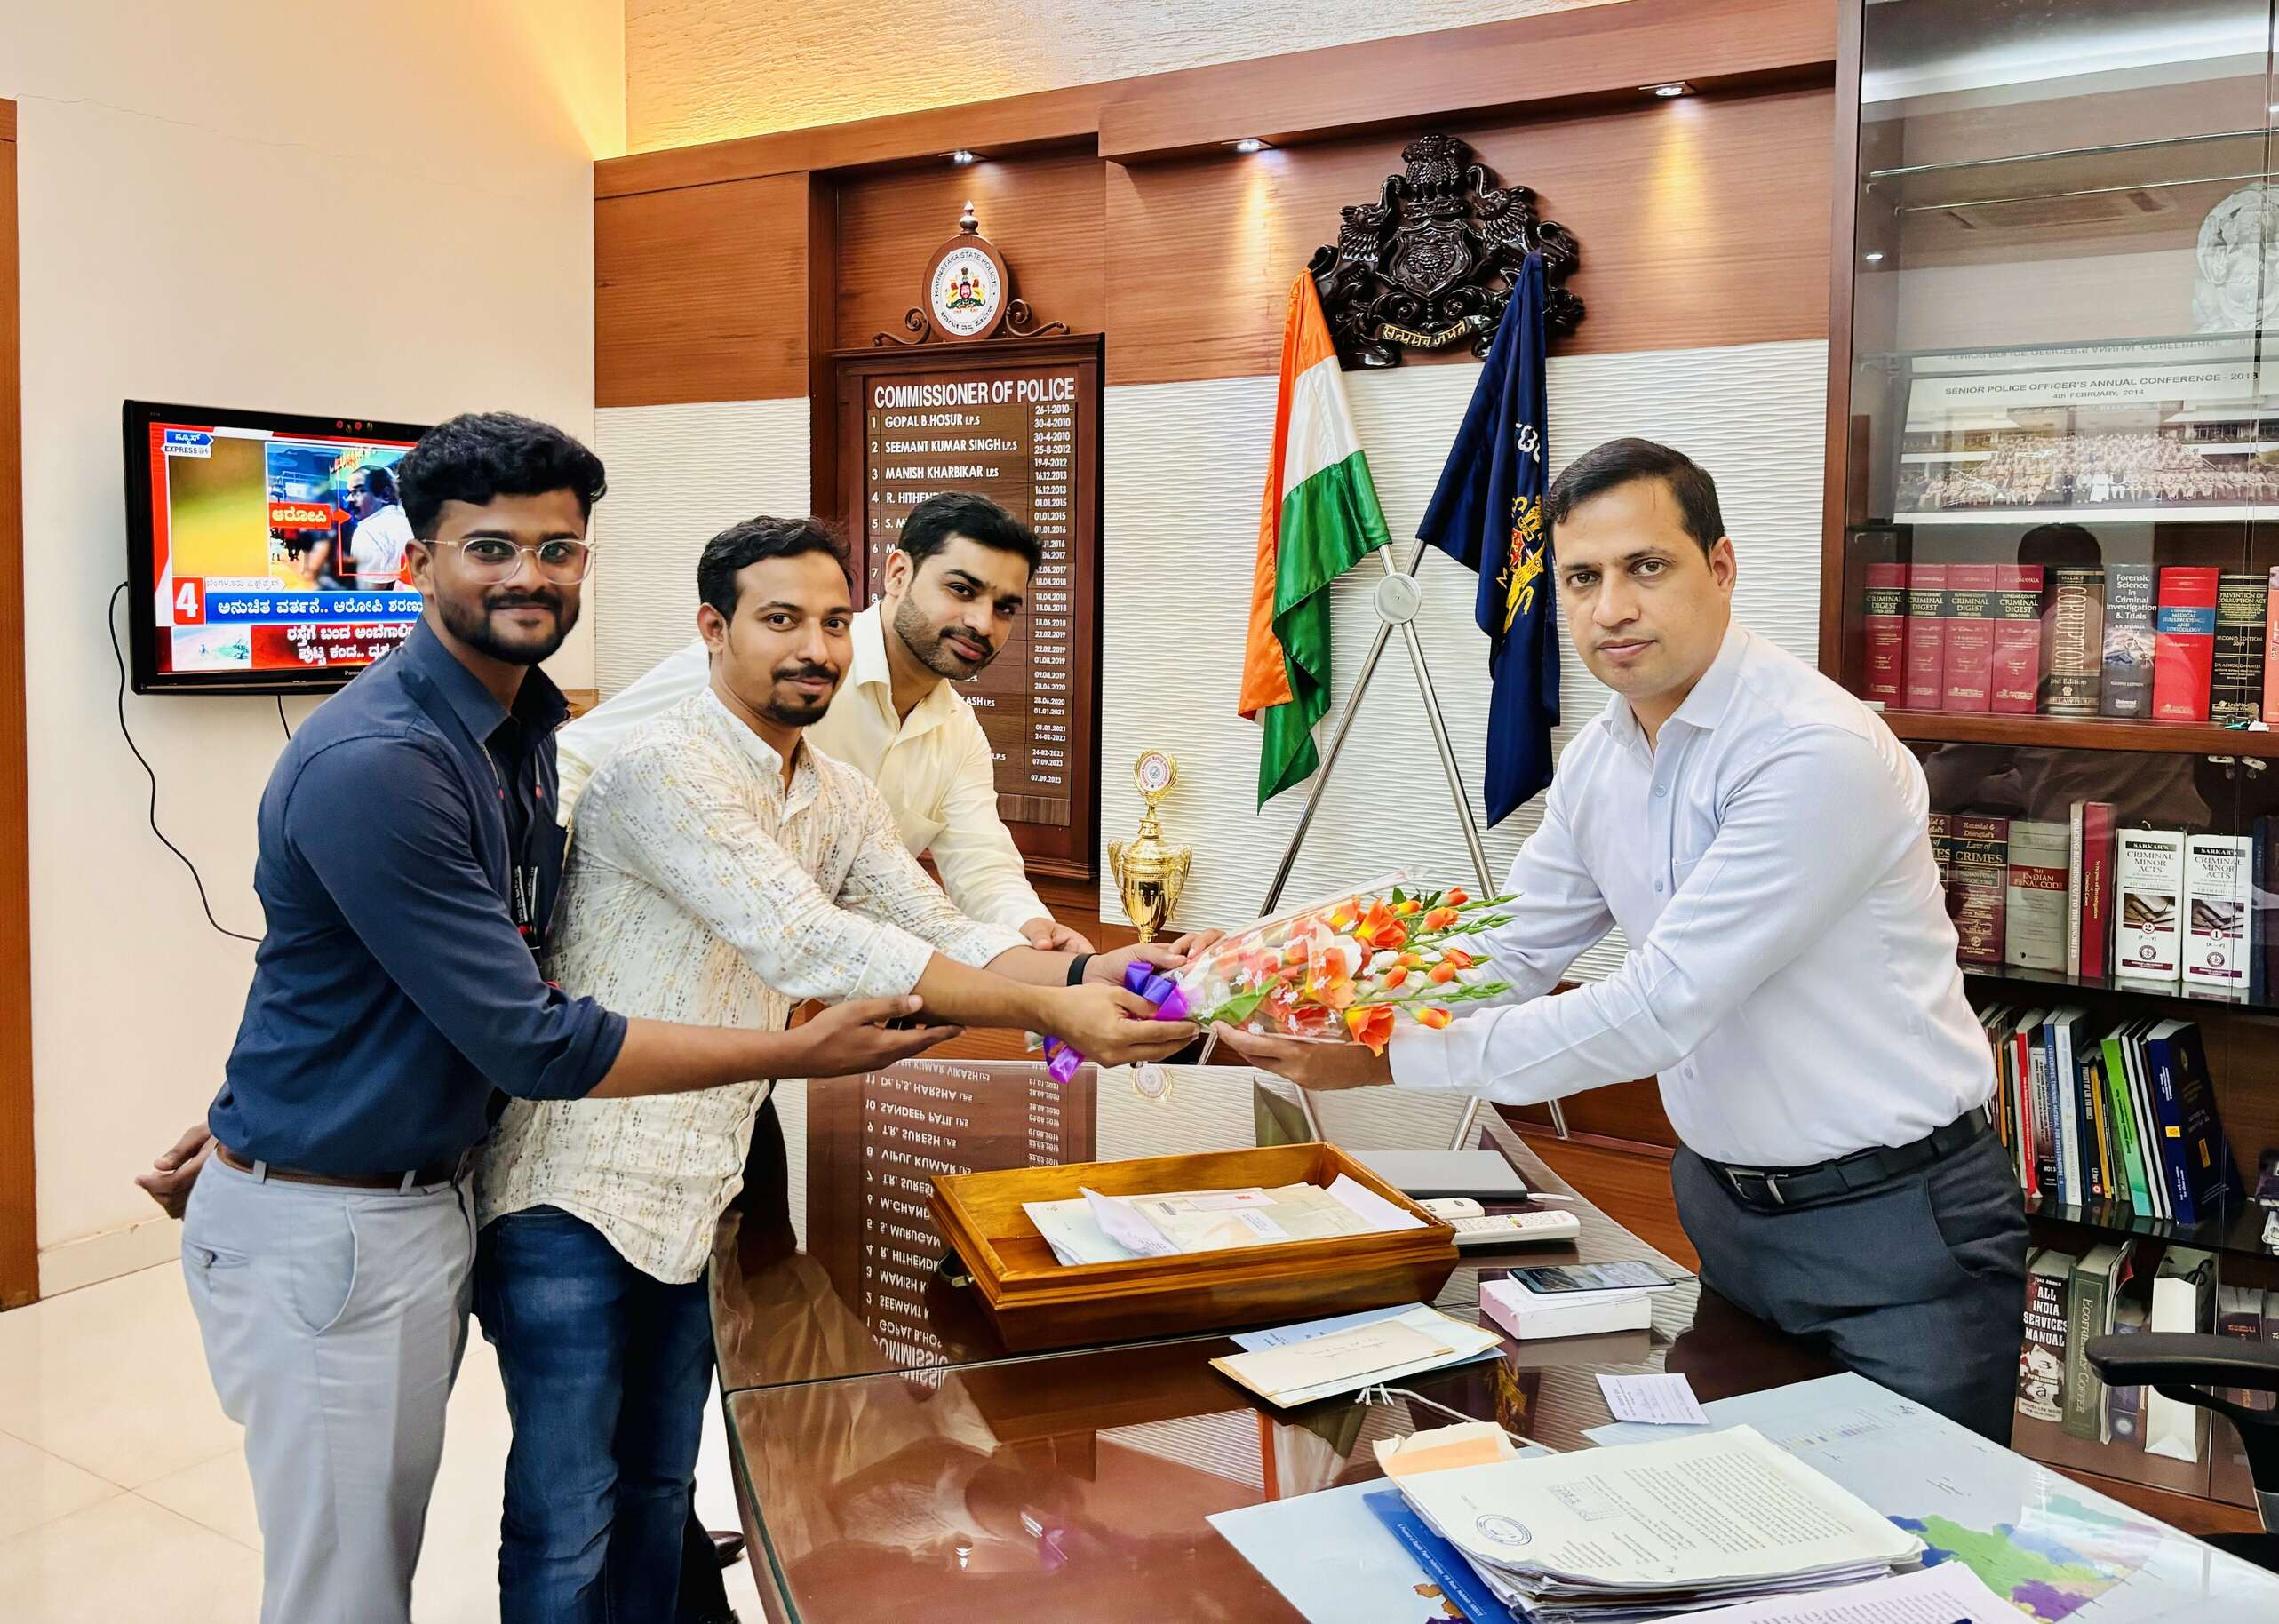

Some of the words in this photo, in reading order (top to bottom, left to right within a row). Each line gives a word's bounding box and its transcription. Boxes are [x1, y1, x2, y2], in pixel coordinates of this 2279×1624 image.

[960, 251, 981, 261] STATE
[1383, 323, 1432, 347] सत्यमेव
[1434, 320, 1466, 345] जयते
[1945, 386, 1986, 395] SENIOR
[1987, 384, 2028, 394] POLICE
[2029, 381, 2087, 392] OFFICER'S
[2090, 378, 2137, 388] ANNUAL
[2140, 373, 2221, 386] CONFERENCE
[874, 383, 988, 409] COMMISSIONER
[992, 380, 1014, 404] OF
[1017, 378, 1076, 403] POLICE
[872, 417, 877, 428] 1
[885, 416, 919, 428] GOPAL
[921, 413, 963, 427] B.HOSUR
[1034, 418, 1071, 428] 30-4-2010
[1033, 432, 1071, 442] 30-4-2010
[872, 442, 879, 453] 2
[885, 441, 928, 453] SEEMANT
[931, 440, 967, 452] KUMAR
[969, 439, 1001, 451] SINGH
[1034, 445, 1071, 455] 25-8-2012
[1034, 458, 1068, 467] 19-9-2012
[872, 469, 879, 481] 3
[885, 466, 925, 480] MANISH
[927, 465, 983, 479] KHARBIKAR
[1035, 485, 1067, 495] 16.12.2013
[872, 493, 880, 503] 4
[886, 492, 896, 504] R.
[1035, 498, 1067, 508] 01.01.2015
[272, 506, 327, 523] ಆರೋಪಿ
[1034, 512, 1066, 521] 01.01.2015
[872, 519, 878, 529] 5
[886, 519, 894, 529] S.
[872, 544, 879, 553] 6
[872, 568, 879, 577] 7
[175, 582, 199, 618] 4
[218, 599, 271, 615] ಅನುಚಿತ
[334, 598, 383, 614] ಆರೋಪಿ
[2107, 603, 2157, 612] Investigation
[2055, 586, 2087, 670] CORRUPTION
[287, 625, 316, 647] ರಸ್ತೆಗೆ
[321, 626, 351, 641] ಬಂದ
[299, 645, 327, 666] ಪುಟ್ಟ
[1984, 842, 1992, 852] of
[1956, 851, 2004, 864] CRIMES
[2127, 851, 2175, 861] CRIMINAL
[2195, 856, 2243, 866] CRIMINAL
[2014, 879, 2042, 888] PENAL
[2044, 880, 2063, 889] CODE
[2037, 1286, 2057, 1302] ALL
[2033, 1300, 2060, 1317] INDIA
[2023, 1311, 2068, 1333] SERVICES
[2025, 1327, 2066, 1348] MANUAL
